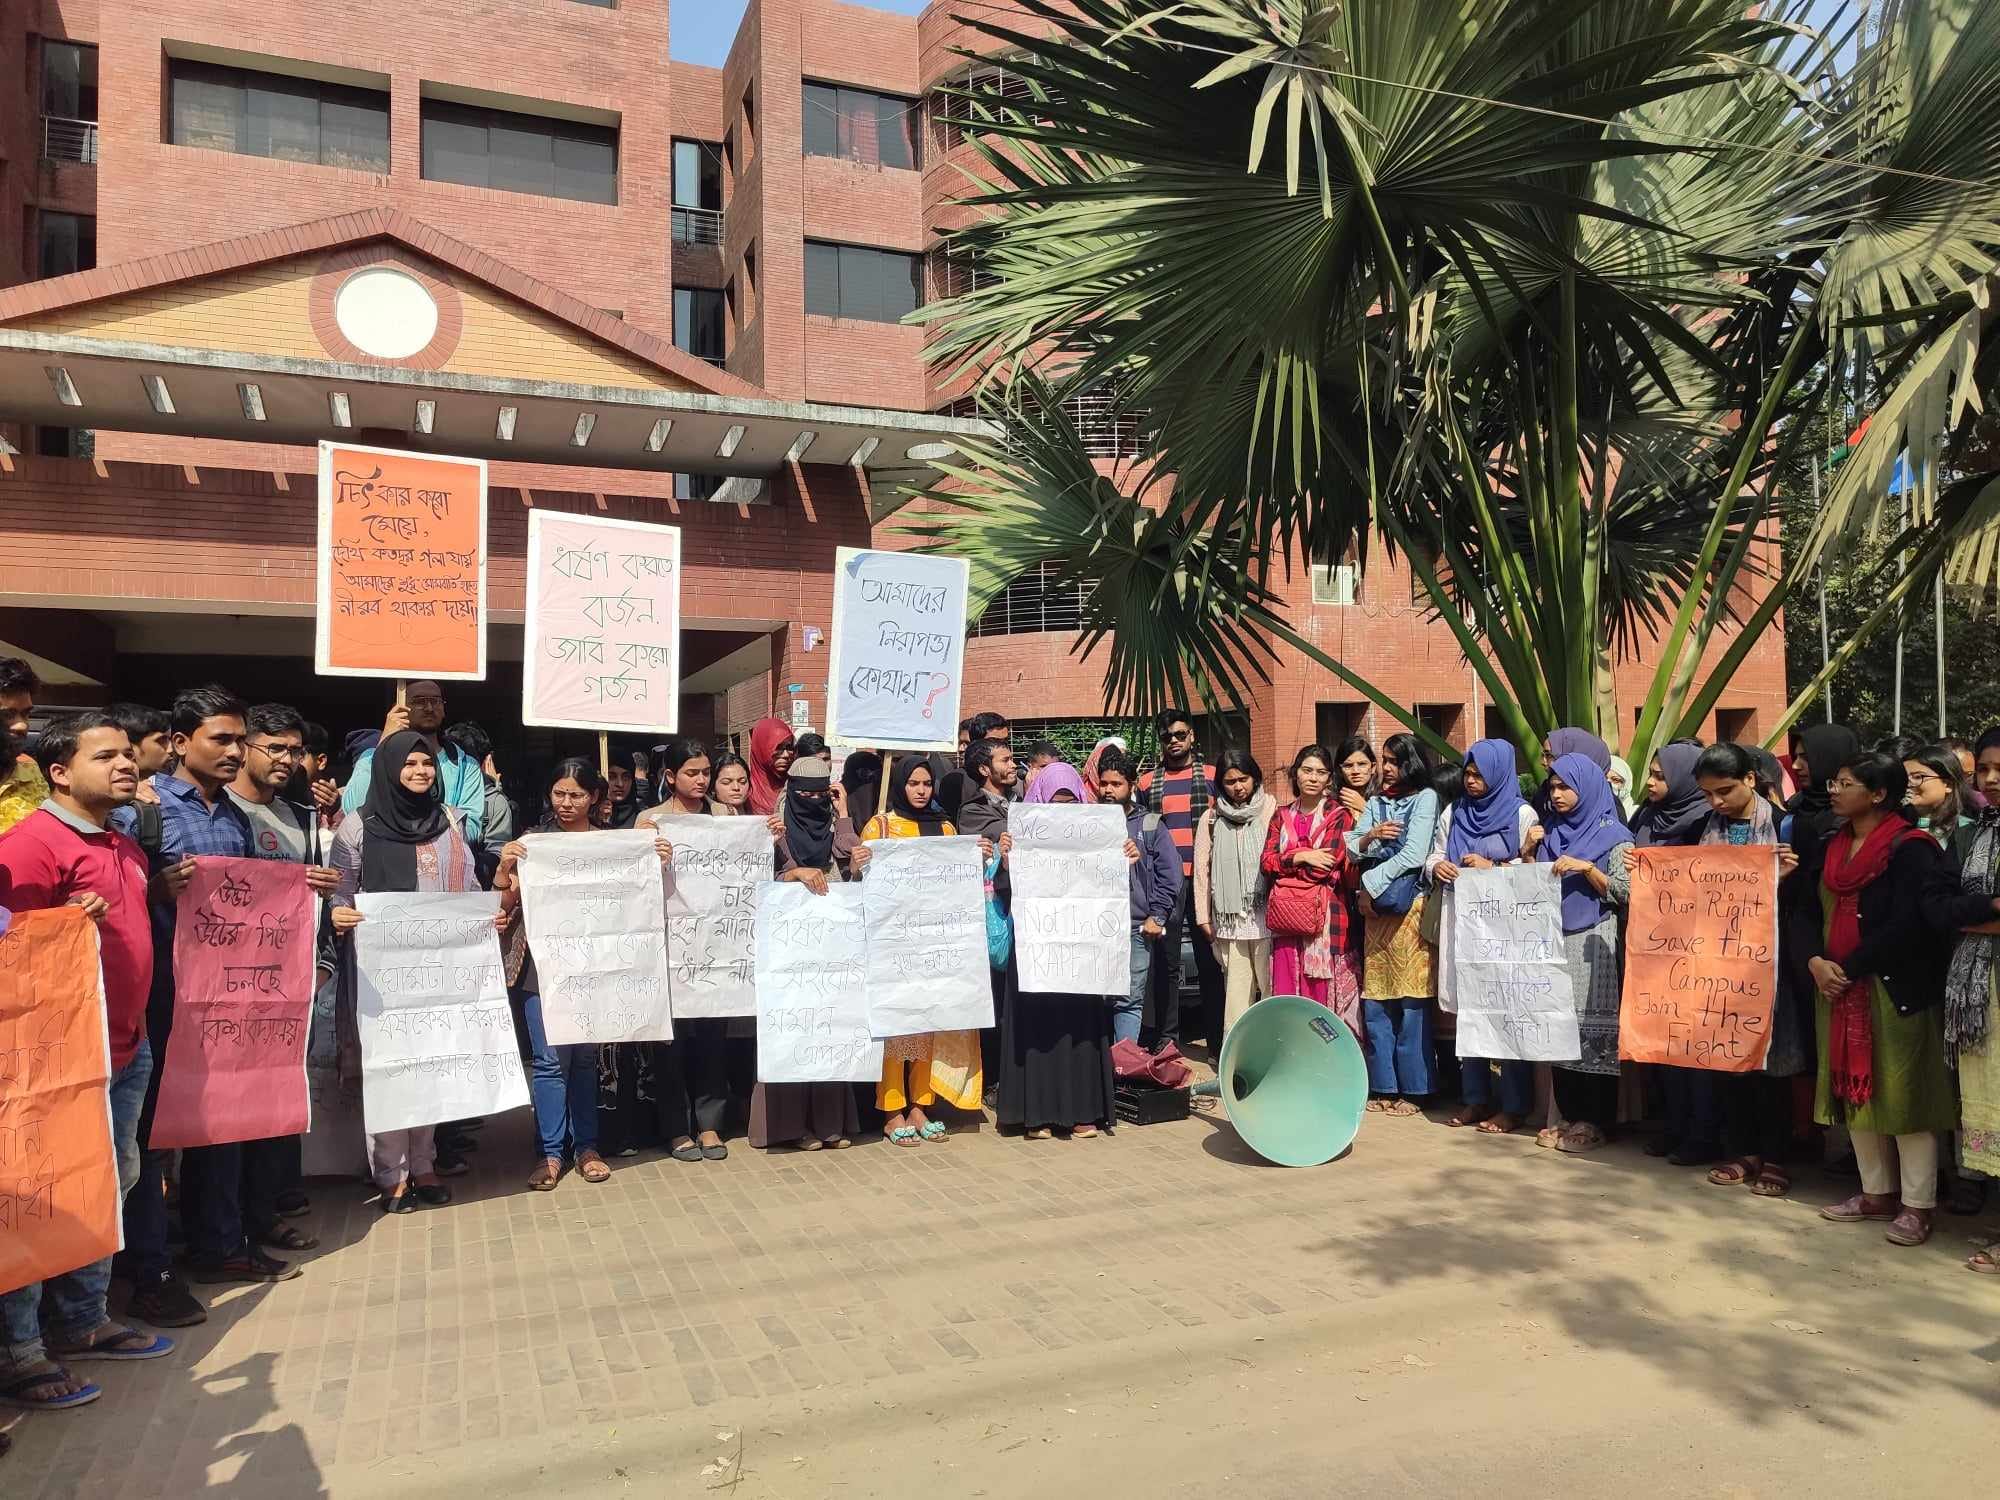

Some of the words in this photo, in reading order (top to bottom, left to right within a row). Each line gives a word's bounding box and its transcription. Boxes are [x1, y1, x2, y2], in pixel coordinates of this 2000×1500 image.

[552, 539, 609, 581] ধর্ষণ
[861, 579, 948, 614] আমাদের
[1018, 814, 1049, 841] We
[1063, 822, 1100, 841] are
[1638, 854, 1680, 884] Our
[1689, 857, 1760, 892] Campus
[1024, 904, 1060, 935] Not
[1658, 890, 1695, 916] Our
[1706, 890, 1764, 933] Right
[1648, 924, 1705, 955] Save
[1718, 929, 1772, 964] the
[1668, 956, 1761, 996] Campus
[1633, 992, 1680, 1018] Join
[1697, 995, 1763, 1035] the
[1666, 1021, 1745, 1068] Fight
